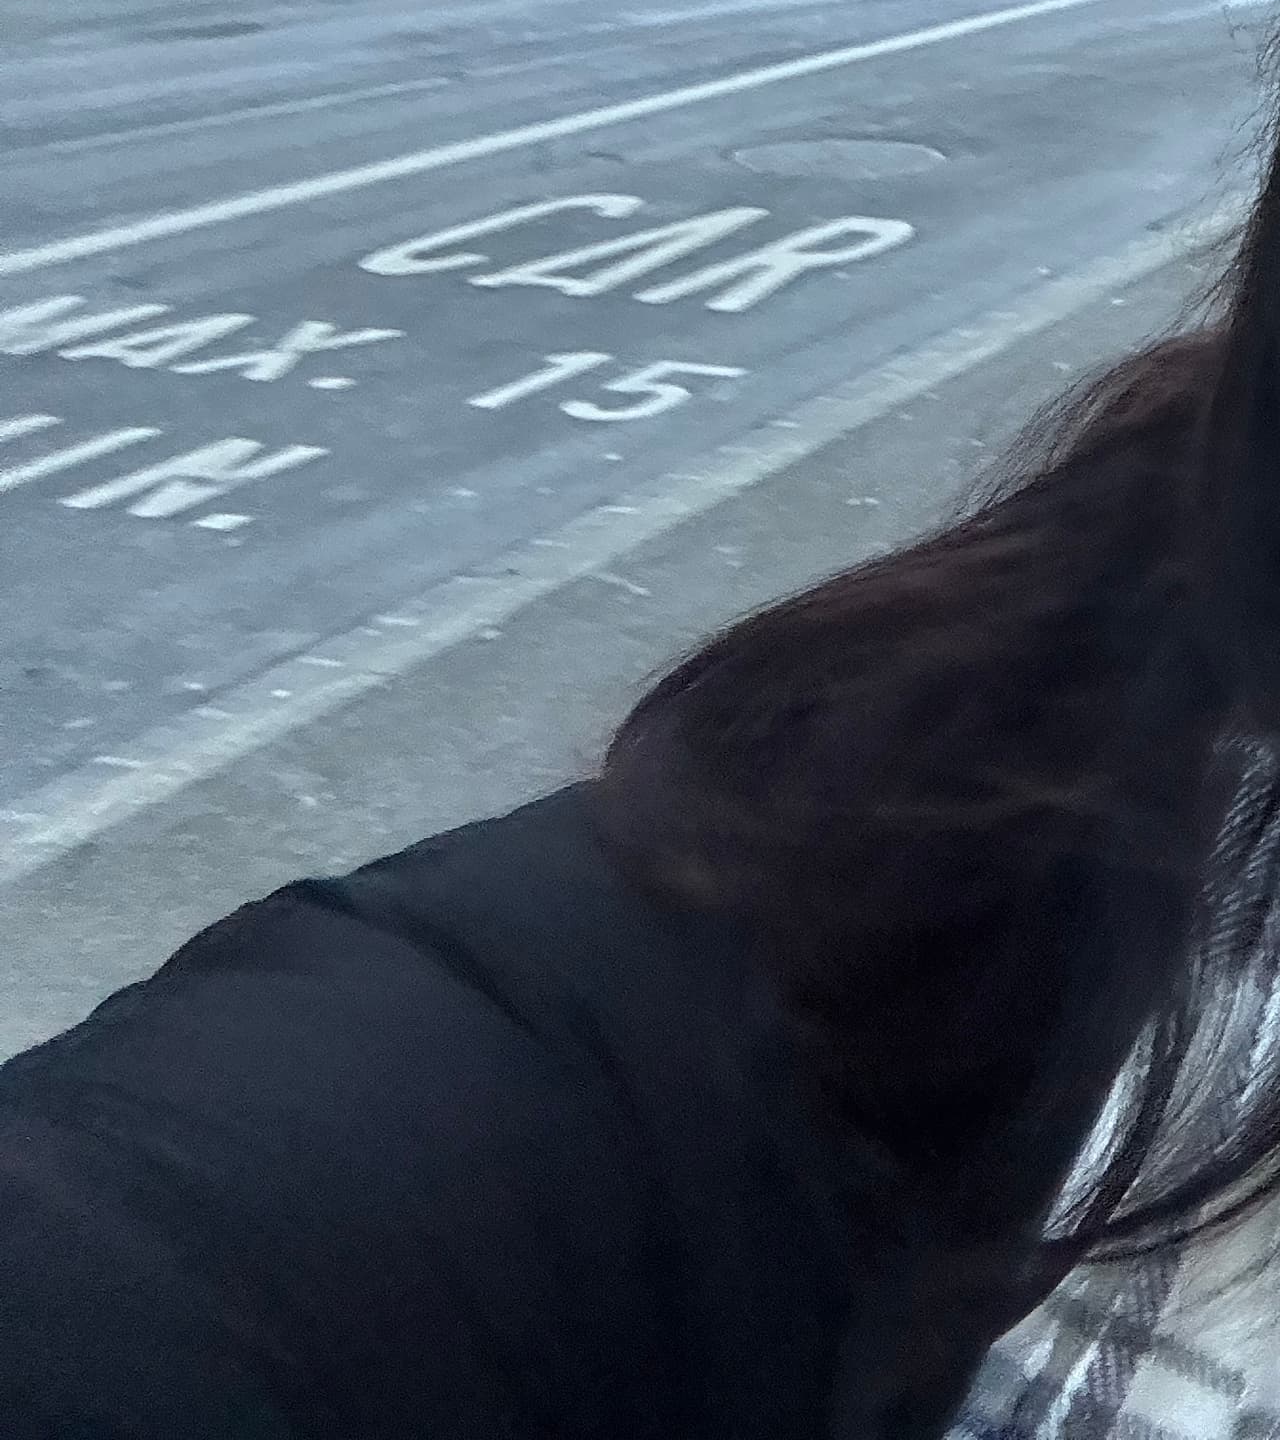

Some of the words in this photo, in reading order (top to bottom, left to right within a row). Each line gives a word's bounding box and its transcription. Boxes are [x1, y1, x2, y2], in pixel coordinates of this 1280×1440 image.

[358, 193, 915, 312] CAR
[467, 351, 750, 421] 15
[0, 413, 331, 530] IN.
